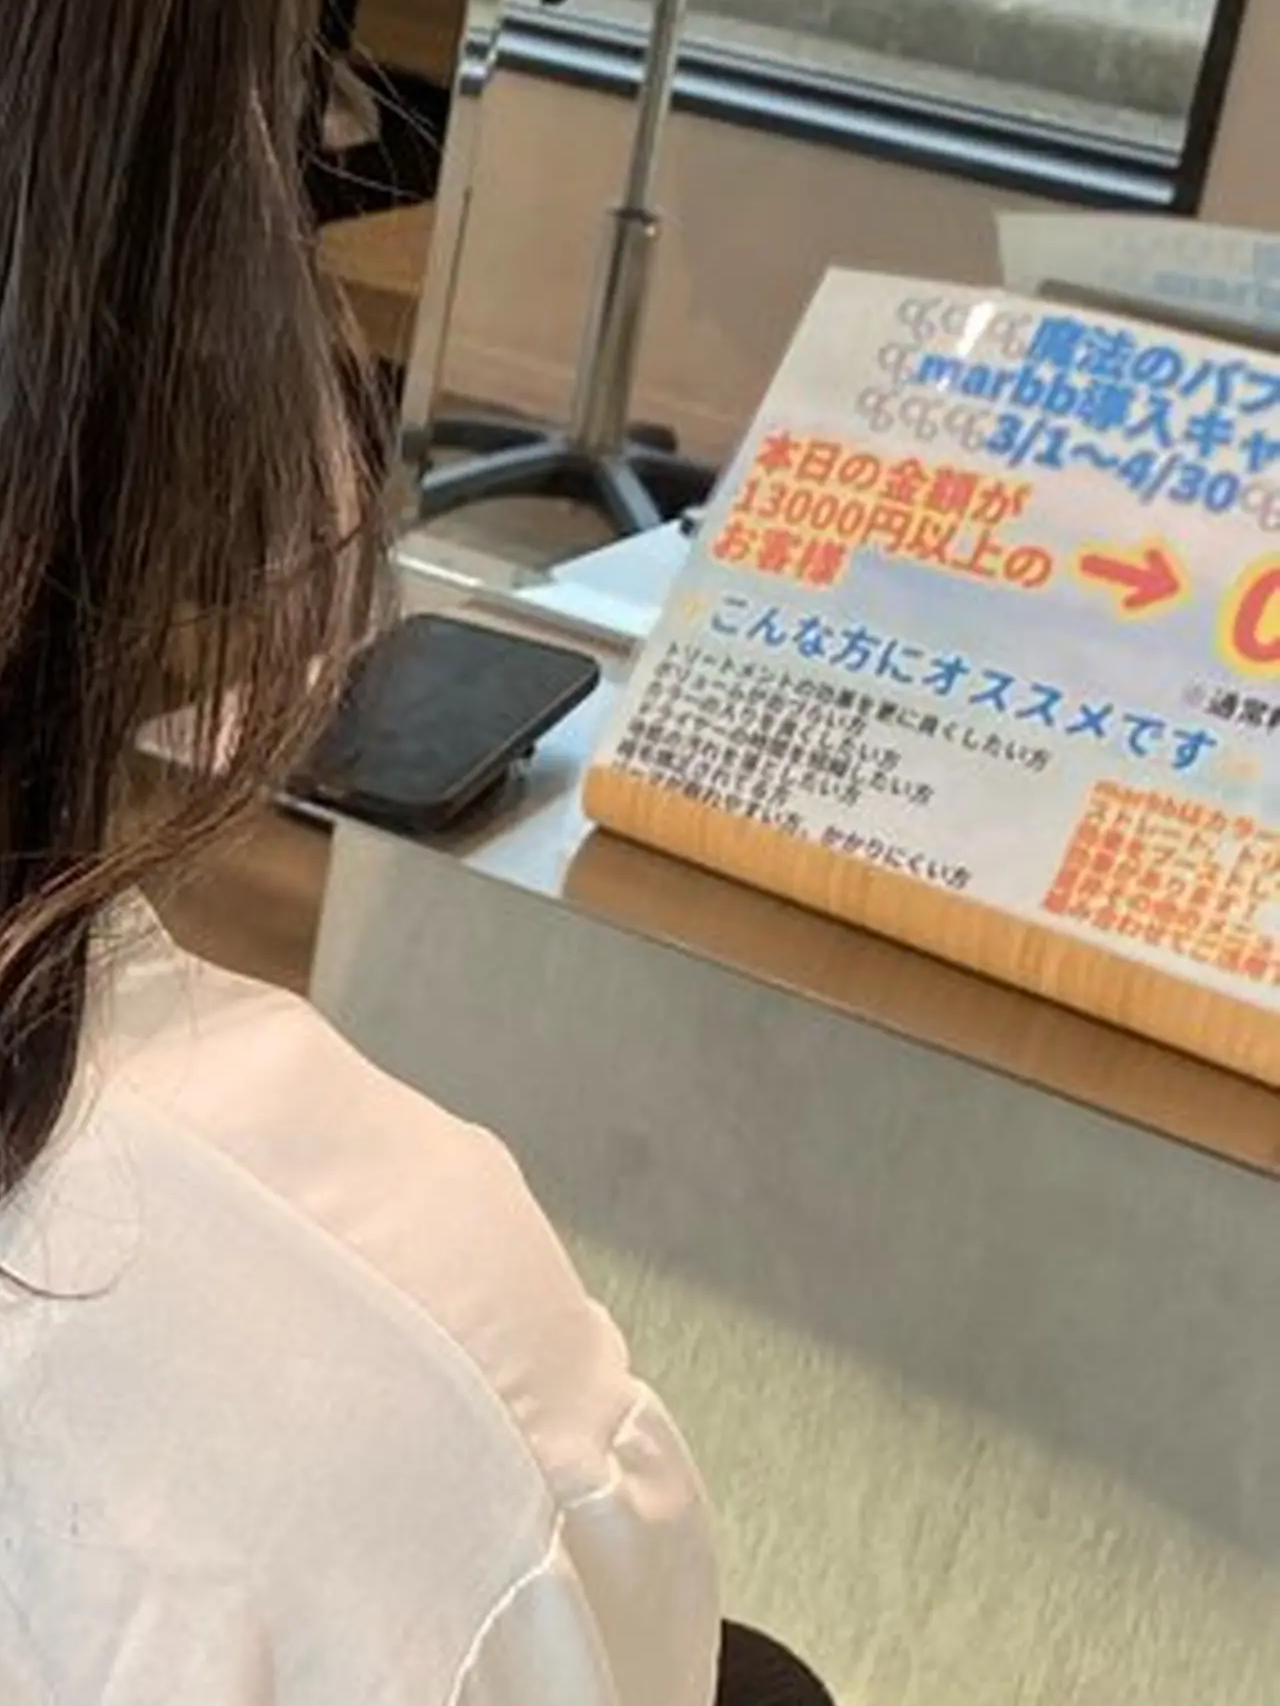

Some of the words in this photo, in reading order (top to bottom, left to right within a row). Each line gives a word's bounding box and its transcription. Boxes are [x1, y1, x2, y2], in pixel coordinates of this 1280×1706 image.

[756, 430, 1033, 524] 本日の金額が
[713, 519, 845, 584] お客様
[733, 477, 1053, 587] 13000円以上の
[710, 595, 1218, 770] こんな方にオススメです
